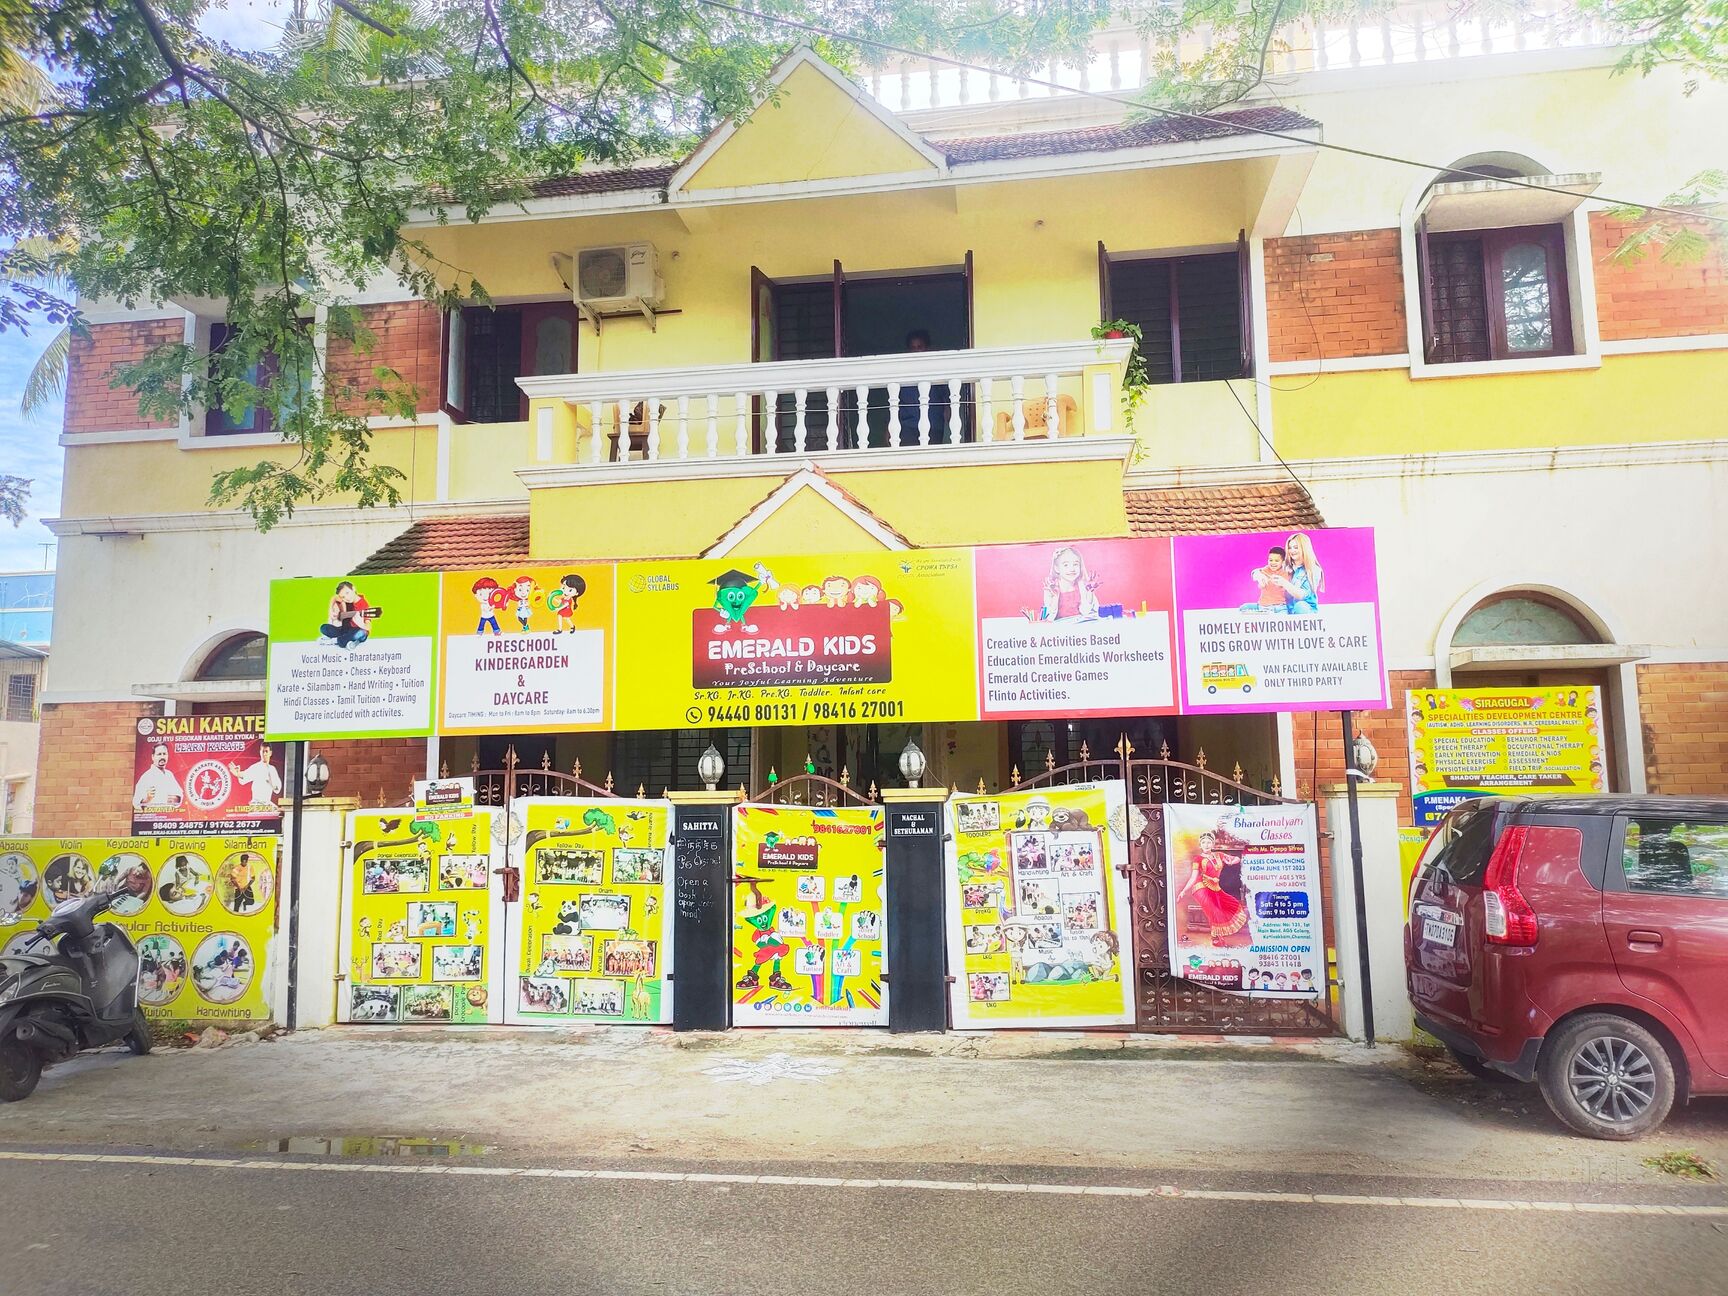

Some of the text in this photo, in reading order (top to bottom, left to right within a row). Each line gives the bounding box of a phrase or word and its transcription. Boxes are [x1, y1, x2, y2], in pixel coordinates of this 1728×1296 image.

[648, 575, 671, 583] GLOBAL
[648, 582, 679, 592] SYLLABUS
[1199, 619, 1325, 635] HOMELY ENVIRONMENT,
[487, 639, 557, 653] PRESCHOOL
[708, 635, 876, 660] EMERALD KIDS
[987, 634, 1120, 650] Creative & Activities Based
[1200, 635, 1368, 654] KIDS GROW WITH LOVE & CARE
[302, 652, 402, 663] Vocal Music Bharatanatyam
[475, 655, 569, 671] KINDERGARDEN
[988, 650, 1164, 667] Education Emeraldkids Worksheets
[292, 665, 410, 678] Western Dance Chess Keyboard
[725, 660, 860, 675] PreSchool & Daycare
[1263, 662, 1368, 674] VAN FACILITY AVAILABLE
[518, 675, 525, 687] &
[988, 670, 1108, 684] Emerald Creative Games
[1264, 676, 1343, 688] ONLY THIRD PARTY
[277, 679, 424, 693] Karate Silambam Hand Writing Tuition
[284, 693, 416, 706] Hindi Classes Tamil Tuition Drawing
[493, 691, 548, 706] DAYCARE
[694, 692, 721, 701] Sr.KG.
[728, 691, 754, 700] Jr.KG.
[761, 690, 792, 699] Pre.KG.
[800, 689, 832, 697] Toddler.
[840, 687, 863, 695] Infant
[989, 688, 1070, 701] Flinto Activities.
[1475, 699, 1530, 707] SIRAGUGAL
[295, 711, 321, 721] Daycare
[323, 709, 352, 720] included
[354, 709, 370, 718] with
[708, 701, 903, 722] 94440 80131 / 98416 27001
[1428, 713, 1484, 721] SPECIALITIES
[157, 716, 264, 734] SKAI KARATE
[175, 743, 244, 752] LEARN KARATE
[683, 822, 718, 830] SAHITYA
[1234, 817, 1303, 829] Bharatanatyam
[1261, 830, 1292, 840] Classes
[60, 841, 82, 849] Violin
[107, 840, 149, 850] Keyboard
[170, 841, 205, 851] Drawing
[224, 840, 267, 849] Silambam
[155, 922, 212, 933] Activities
[197, 1008, 251, 1018] Handwriting
